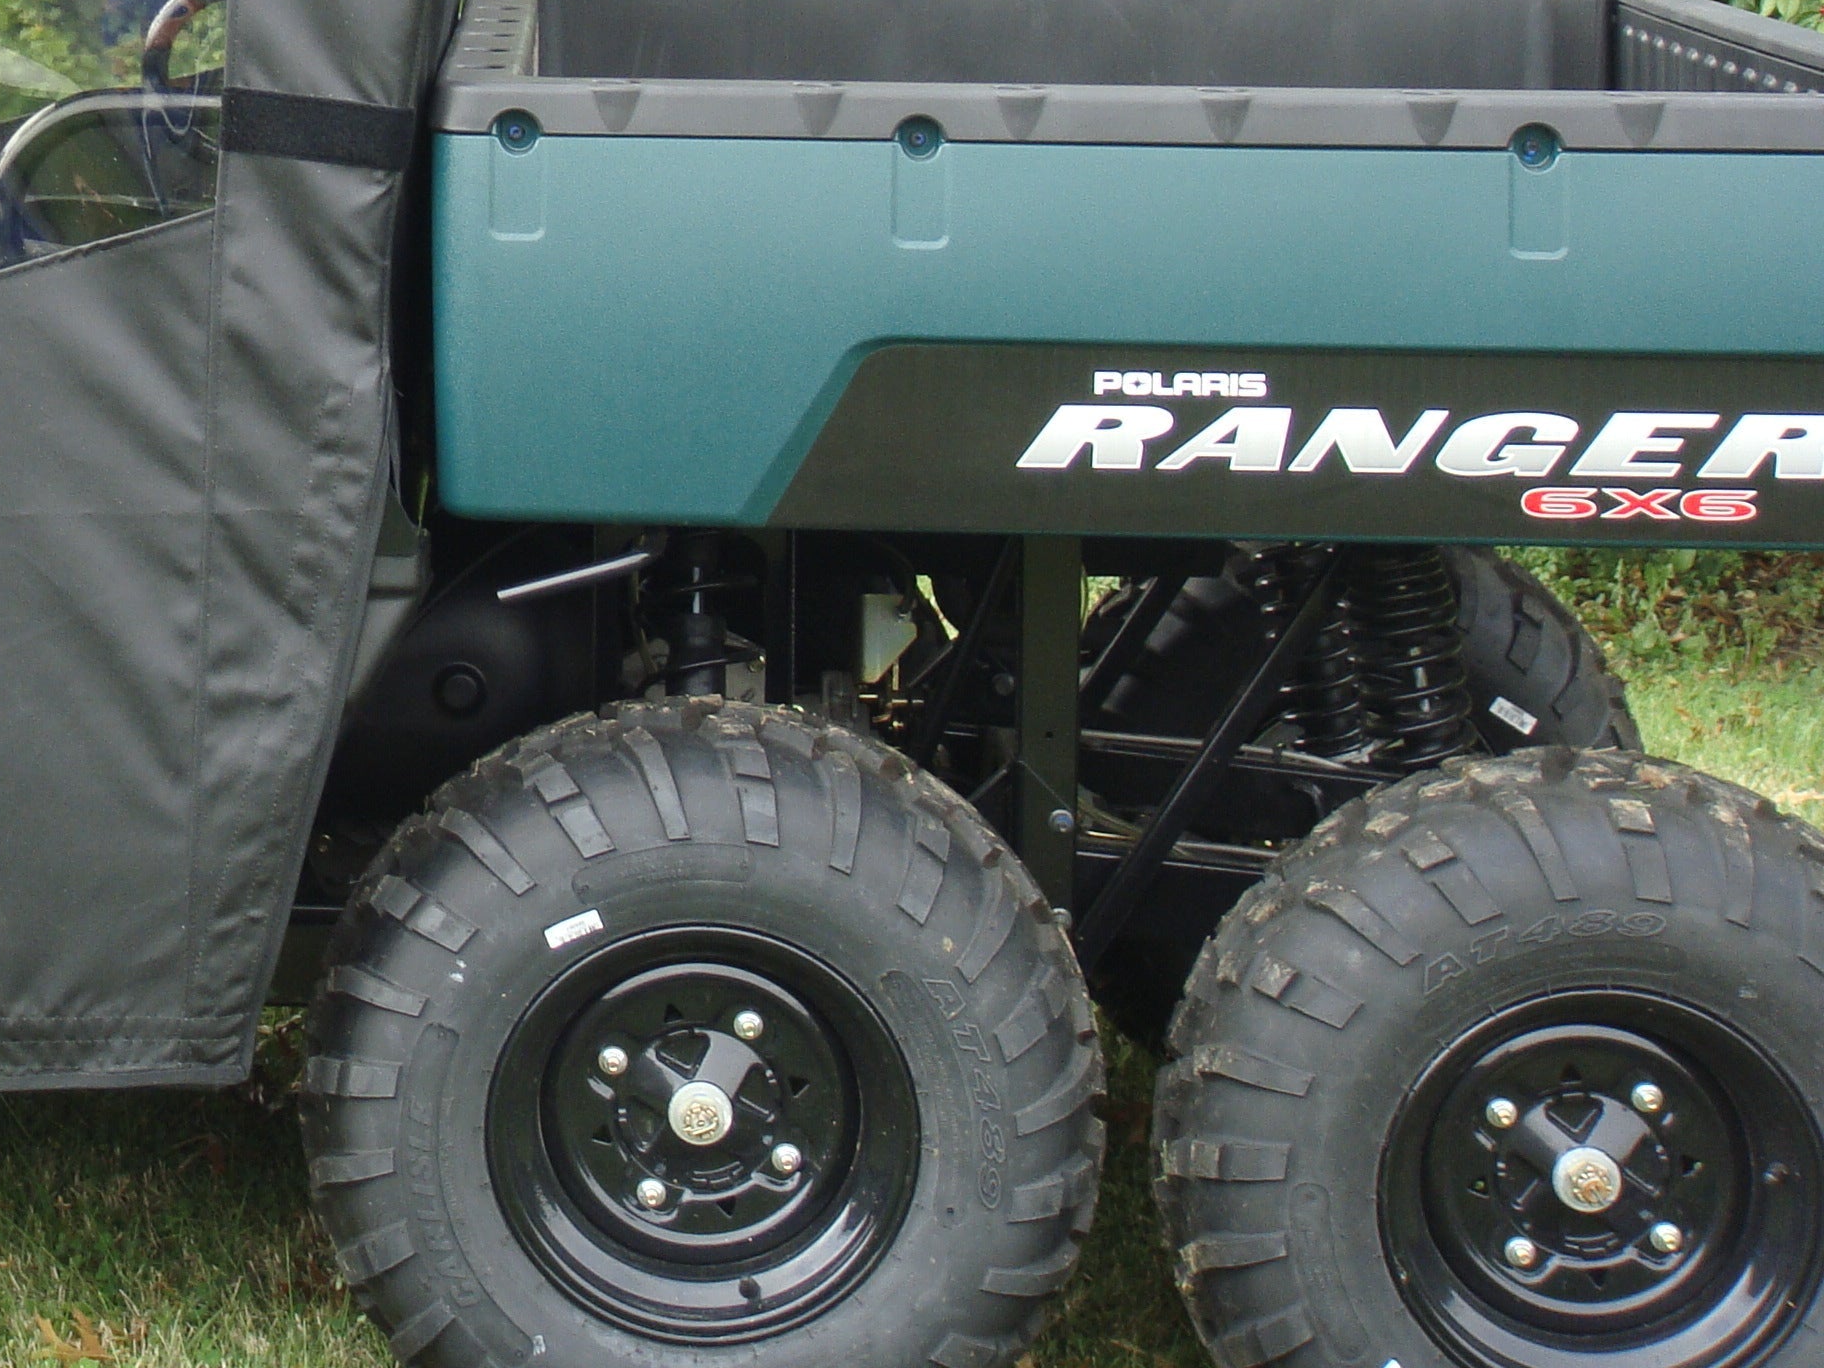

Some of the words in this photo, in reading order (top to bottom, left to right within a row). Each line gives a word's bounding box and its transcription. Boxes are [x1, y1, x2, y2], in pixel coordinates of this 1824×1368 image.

[1093, 371, 1267, 397] POLARIS
[1015, 404, 1824, 479] RANGER
[1520, 488, 1758, 521] 6X6
[1424, 909, 1667, 995] AT489
[922, 978, 1006, 1209] AT489
